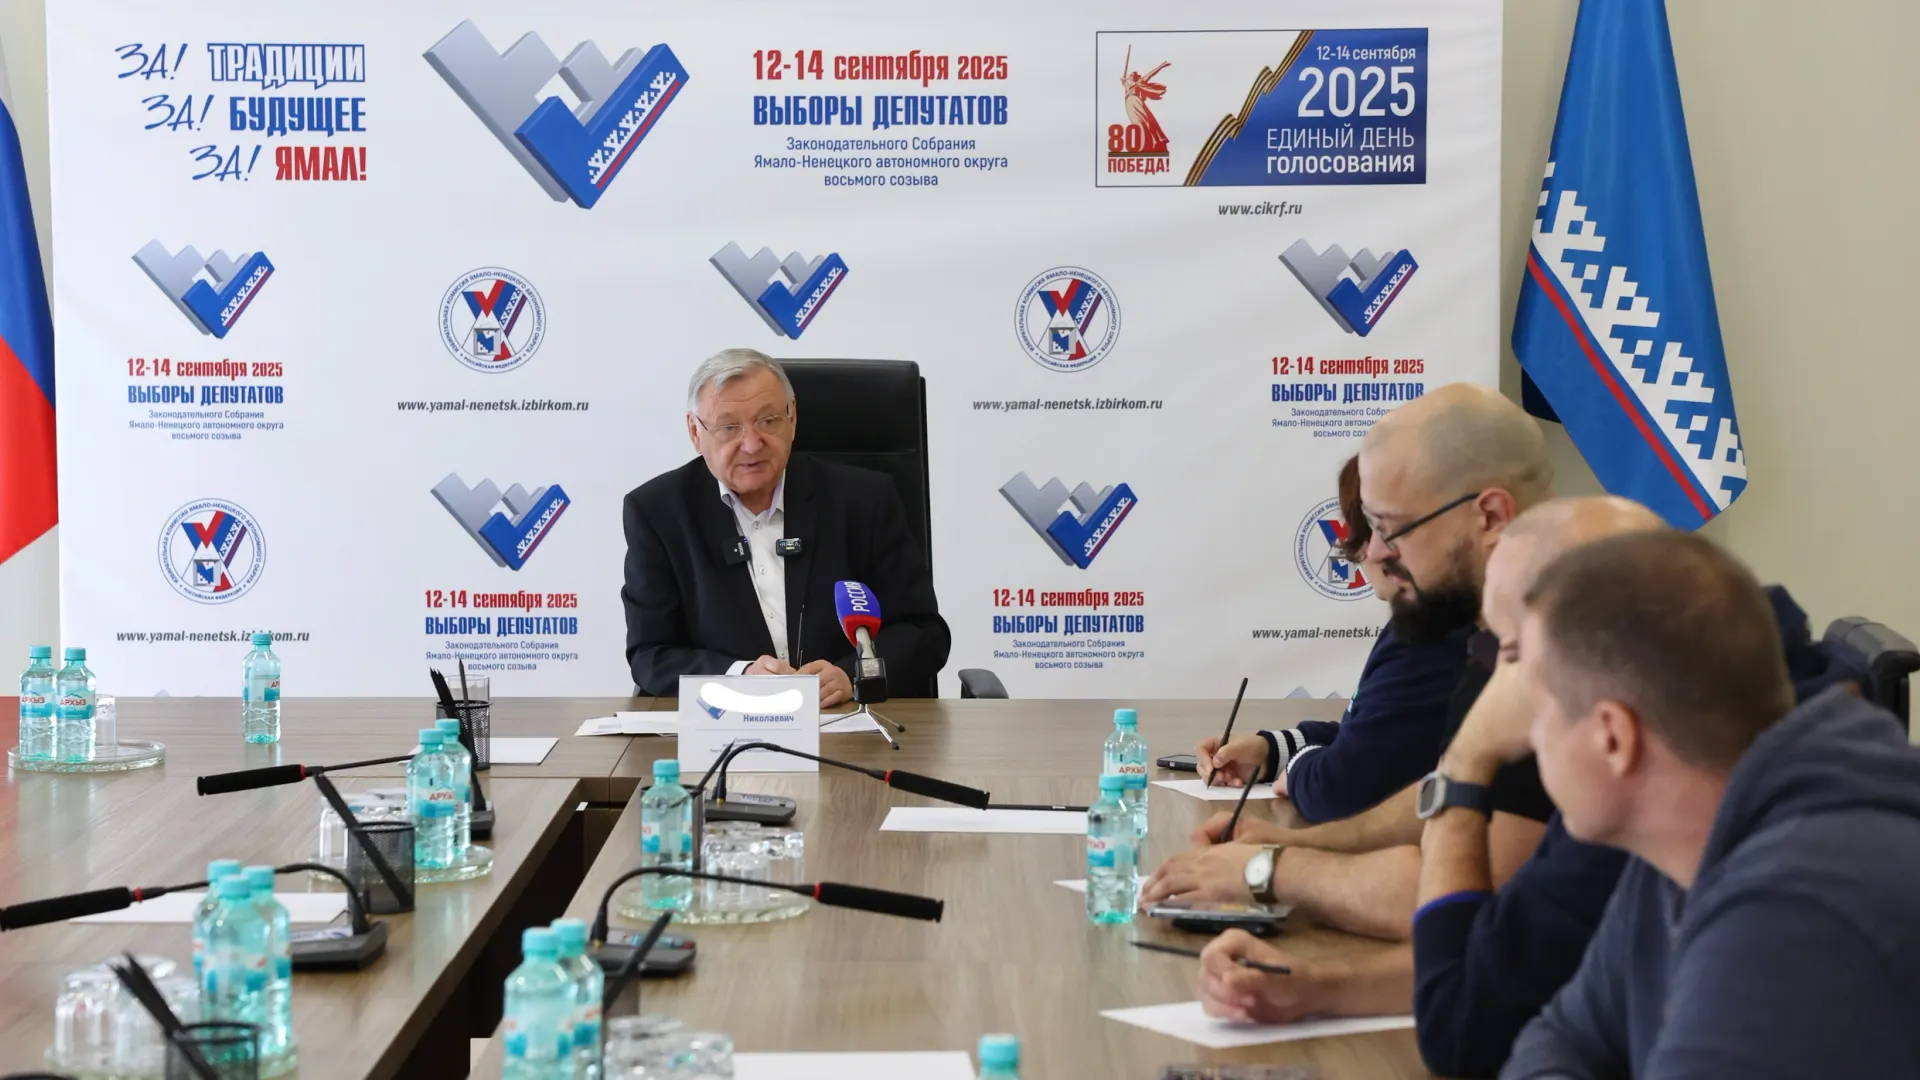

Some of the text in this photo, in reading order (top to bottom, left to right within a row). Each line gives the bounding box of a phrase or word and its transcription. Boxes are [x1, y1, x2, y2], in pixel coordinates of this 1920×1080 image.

[1316, 45, 1416, 62] 12-14 сентября
[114, 42, 365, 90] ЗА! ТРАДИЦИИ
[753, 50, 1008, 88] 12-14 сентября 2025
[1298, 66, 1415, 117] 2025
[142, 94, 366, 138] ЗА! БУДУЩЕЕ
[753, 95, 1008, 131] ВЫБОРЫ ДЕПУТАТОВ
[786, 136, 976, 153] Законодательного Собрания
[1108, 124, 1141, 152] 80
[1267, 123, 1415, 152] ЕДИНЫЙ ДЕНЬ
[190, 145, 366, 182] ЗА! ЯМАЛ!
[754, 155, 1008, 172] Ямало-Ненецкого автономного округа
[1108, 158, 1170, 175] ПОБЕДА!
[1267, 155, 1415, 174] голосования
[825, 174, 938, 187] восьмого созыва
[1218, 200, 1303, 218] www.cikrf.ru
[128, 358, 283, 381] 12-14 сентября 2025
[1272, 356, 1424, 378] 12-14 сентября 2025
[128, 386, 283, 406] ВЫБОРЫ ДЕПУТАТОВ
[1271, 383, 1424, 404] ВЫБОРЫ ДЕПУТАТОВ
[397, 399, 589, 412] www.yamal-nenetsk.izbirkom.ru
[973, 398, 1163, 412] www.yamal-nenetsk.izbirkom.ru
[1291, 407, 1364, 417] Законодательного
[149, 410, 264, 420] Законодательного Собрания
[129, 421, 284, 431] Ямало-Ненецкого автономного округа
[1271, 419, 1342, 429] Ямало-Ненецкого
[172, 432, 241, 440] восьмого созыва
[1313, 430, 1351, 438] восьмого
[425, 590, 578, 613] 12-14 сентября 2025
[844, 581, 870, 612] РОССИЯ
[993, 589, 1144, 610] 12-14 сентября 2025
[425, 617, 578, 637] ВЫБОРЫ ДЕПУТАТОВ
[993, 615, 1144, 636] ВЫБОРЫ ДЕПУТАТОВ
[445, 640, 559, 650] Законодательного Собрания
[1012, 639, 1125, 649] Законодательного Собрания
[426, 652, 497, 661] Ямало-Ненецкого
[552, 653, 578, 662] округа
[993, 651, 1145, 660] Ямало-Ненецкого автономного округа
[468, 663, 537, 671] восьмого созыва
[1035, 661, 1103, 669] восьмого созыва
[743, 714, 794, 722] Николаевич
